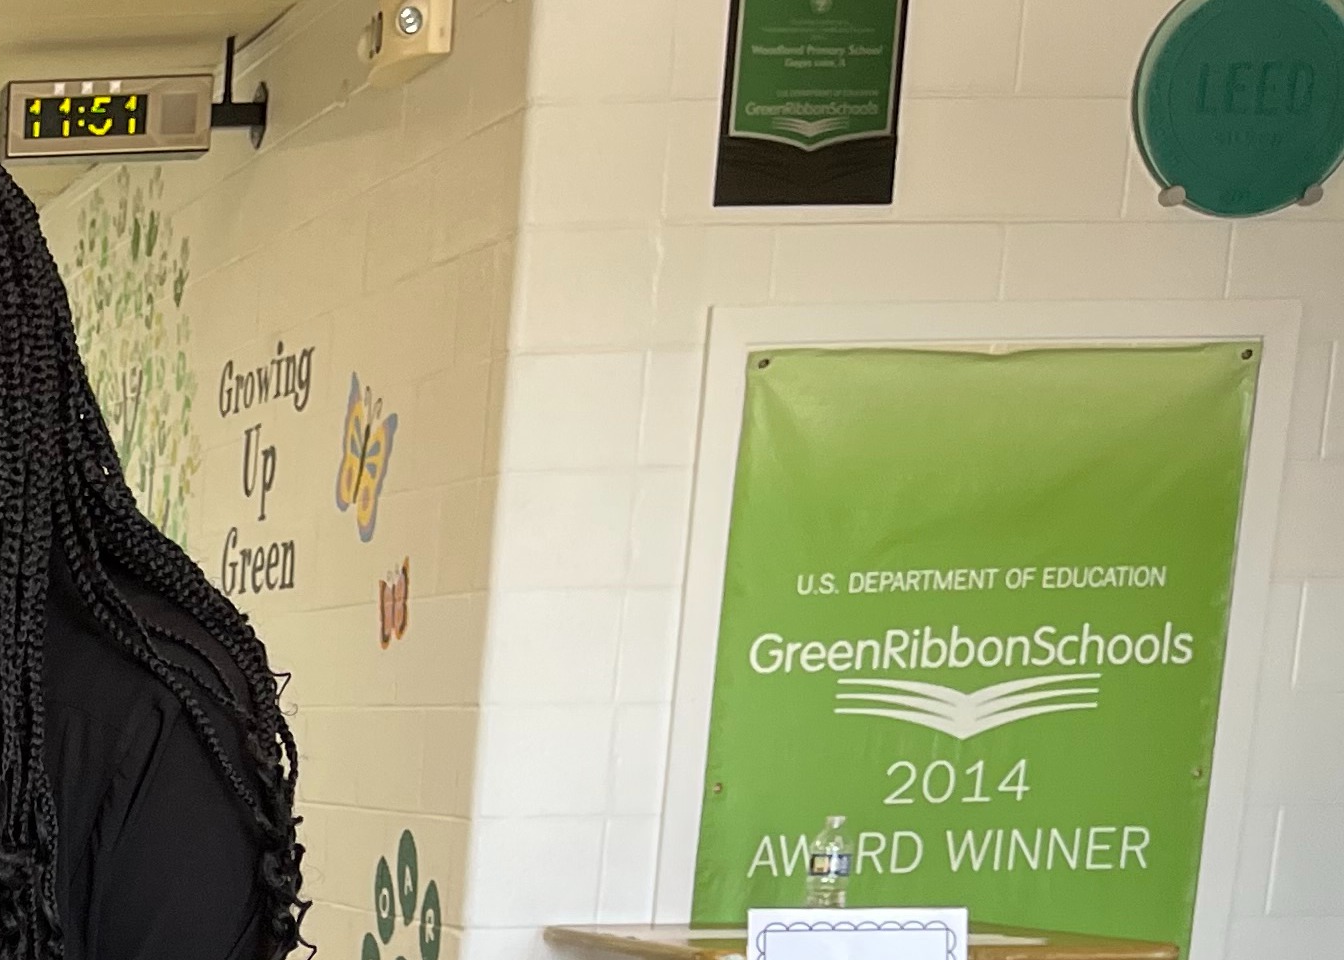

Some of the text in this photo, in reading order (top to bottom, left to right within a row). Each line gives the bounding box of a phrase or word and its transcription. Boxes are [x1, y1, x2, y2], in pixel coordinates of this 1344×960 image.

[745, 101, 879, 116] GreenRibbonSchools
[1196, 61, 1314, 115] LEED
[29, 94, 138, 138] 11:51
[219, 339, 316, 418] Growing
[243, 422, 277, 521] Up
[221, 526, 296, 597] Green
[796, 565, 1167, 596] U.S. DEPARTMENT OF EDUCATION
[748, 621, 1195, 675] GreenRibbonSchools
[883, 757, 1031, 806] 2014
[746, 824, 1151, 878] AWRD WINNER
